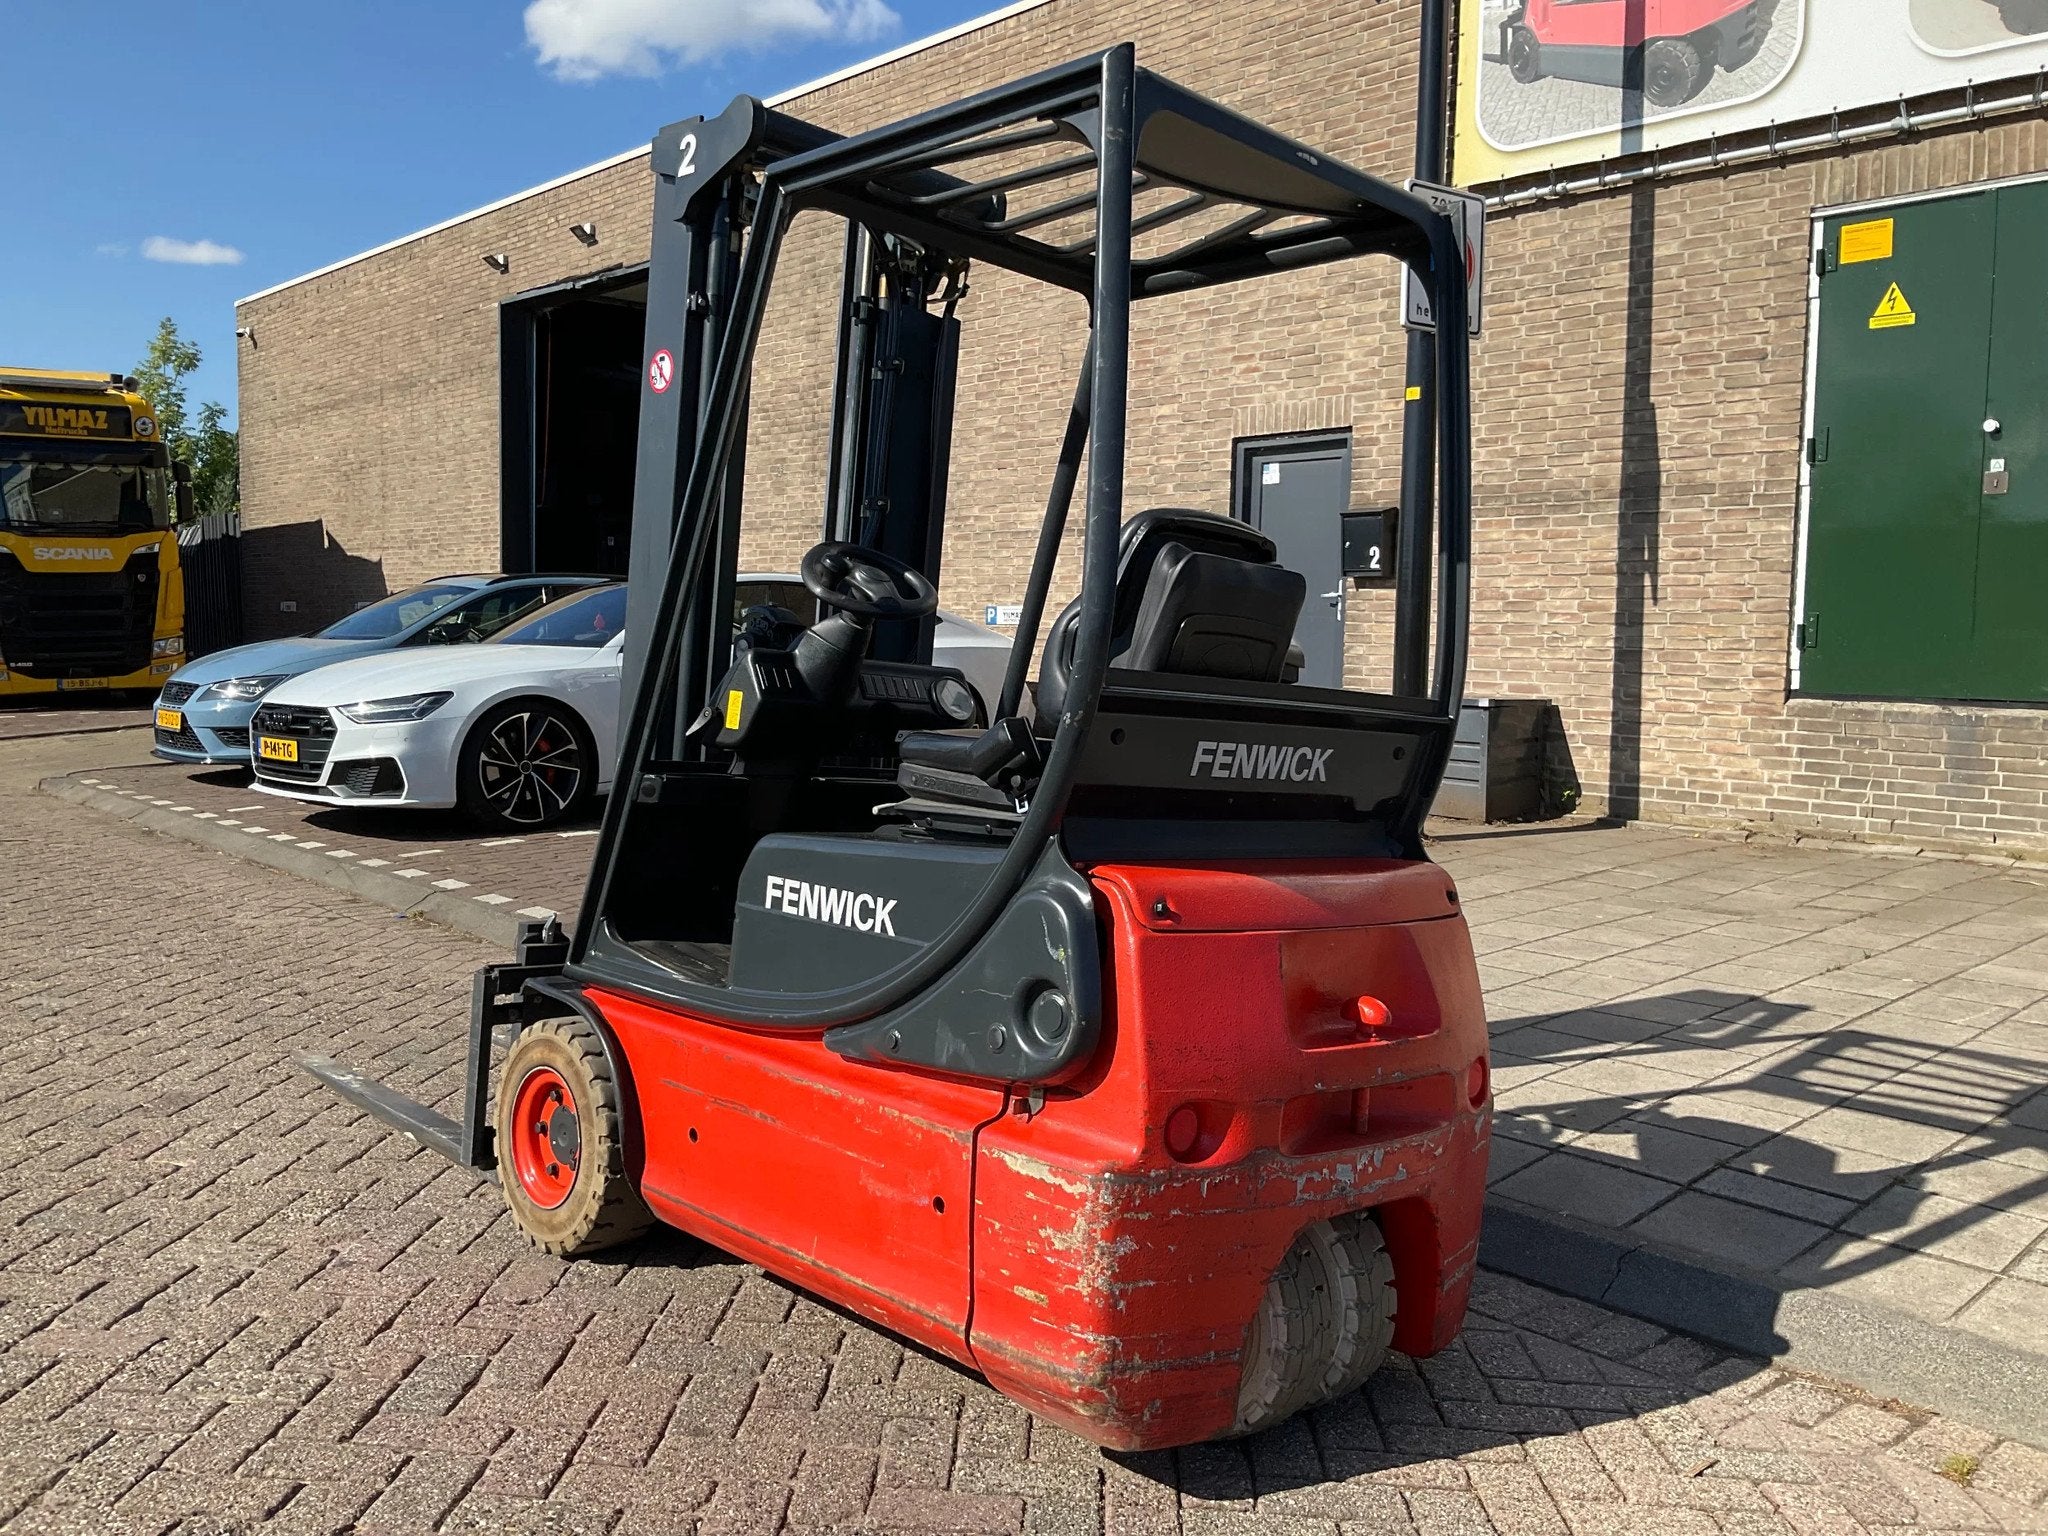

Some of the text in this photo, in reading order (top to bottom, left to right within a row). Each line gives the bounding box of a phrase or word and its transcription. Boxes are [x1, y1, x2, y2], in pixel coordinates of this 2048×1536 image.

[677, 133, 697, 178] 2
[21, 405, 108, 430] YILMAZ
[33, 546, 115, 561] SCANIA
[1369, 545, 1381, 569] 2
[263, 740, 293, 758] P-141-TG
[1189, 740, 1334, 782] FENWICK
[764, 875, 898, 937] FENWICK
